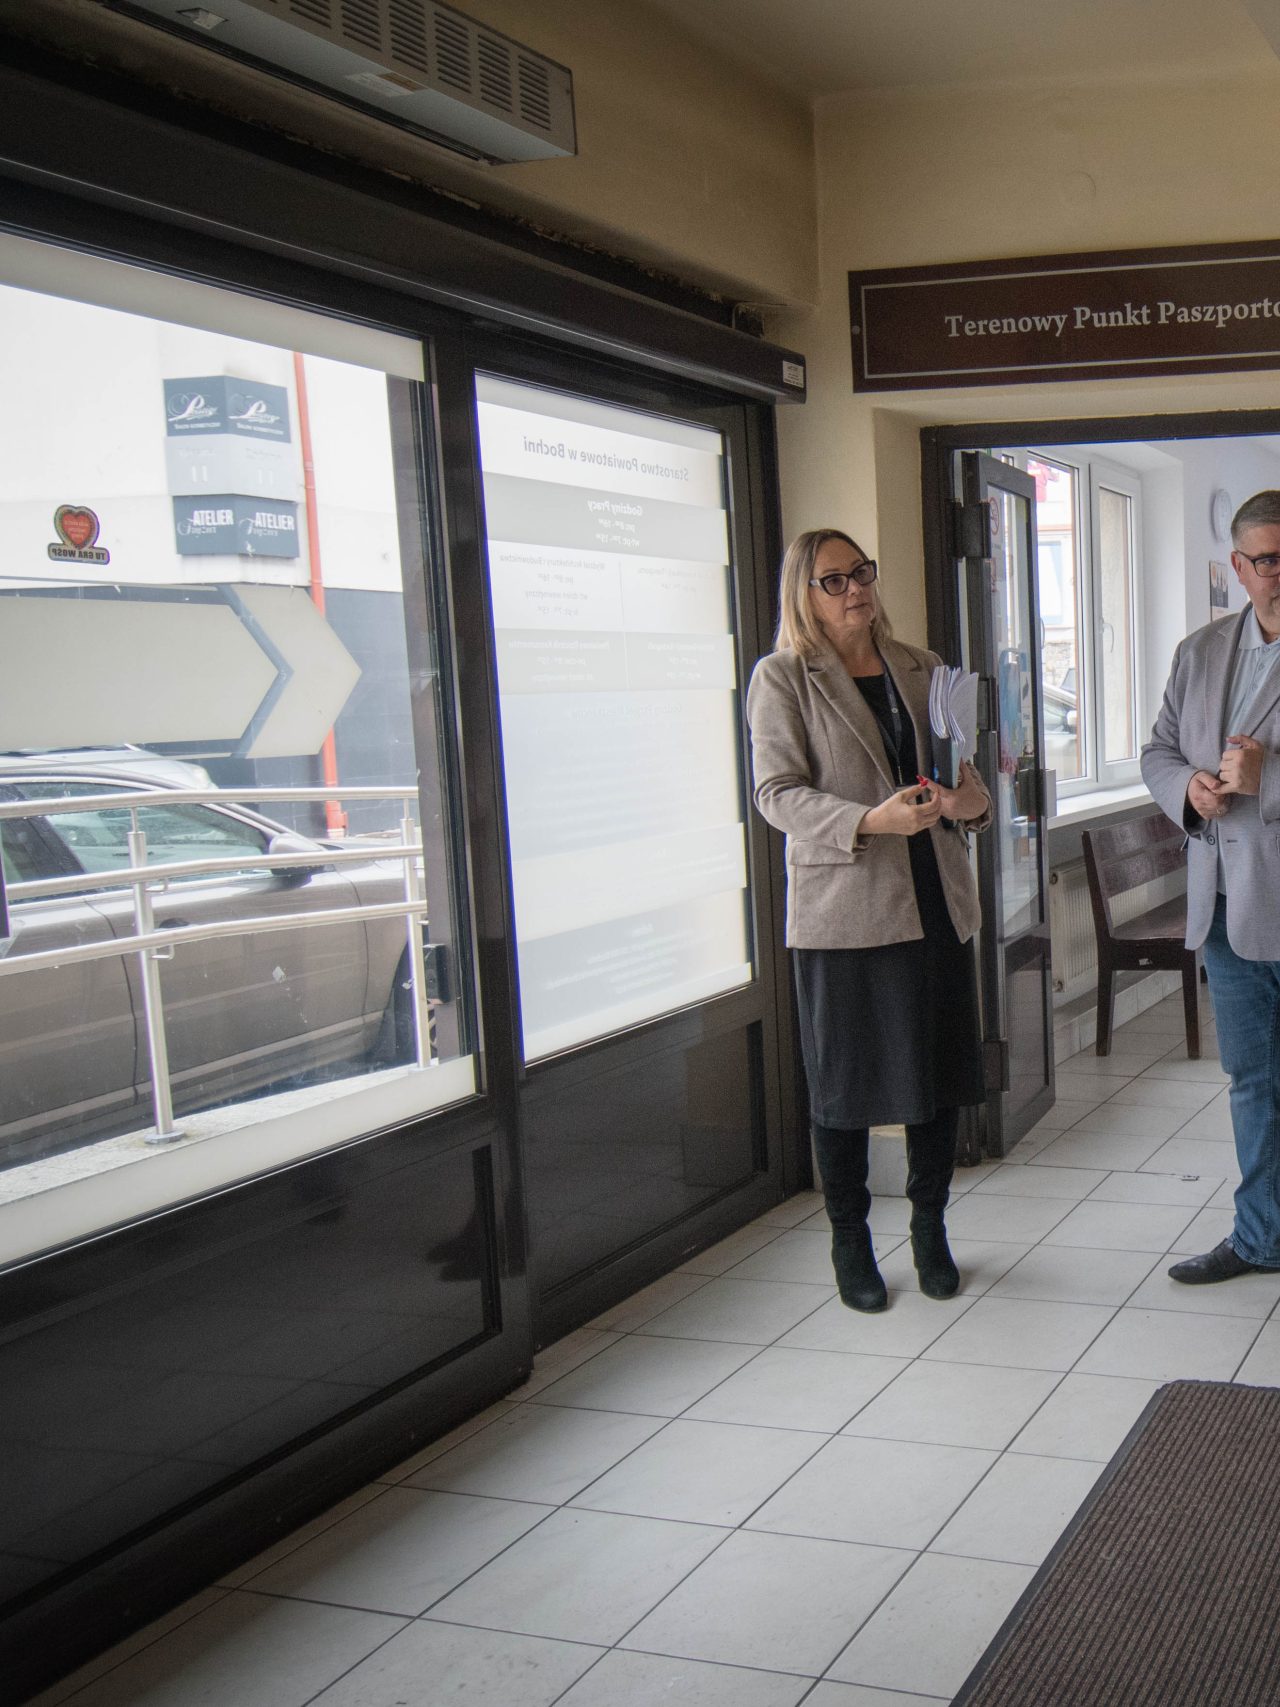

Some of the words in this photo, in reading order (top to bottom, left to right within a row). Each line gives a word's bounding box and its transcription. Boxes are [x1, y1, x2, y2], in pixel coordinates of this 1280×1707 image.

[944, 314, 1068, 336] Terenowy
[1073, 302, 1151, 329] Punkt
[193, 509, 234, 526] ATELIER
[255, 512, 294, 530] ATELIER
